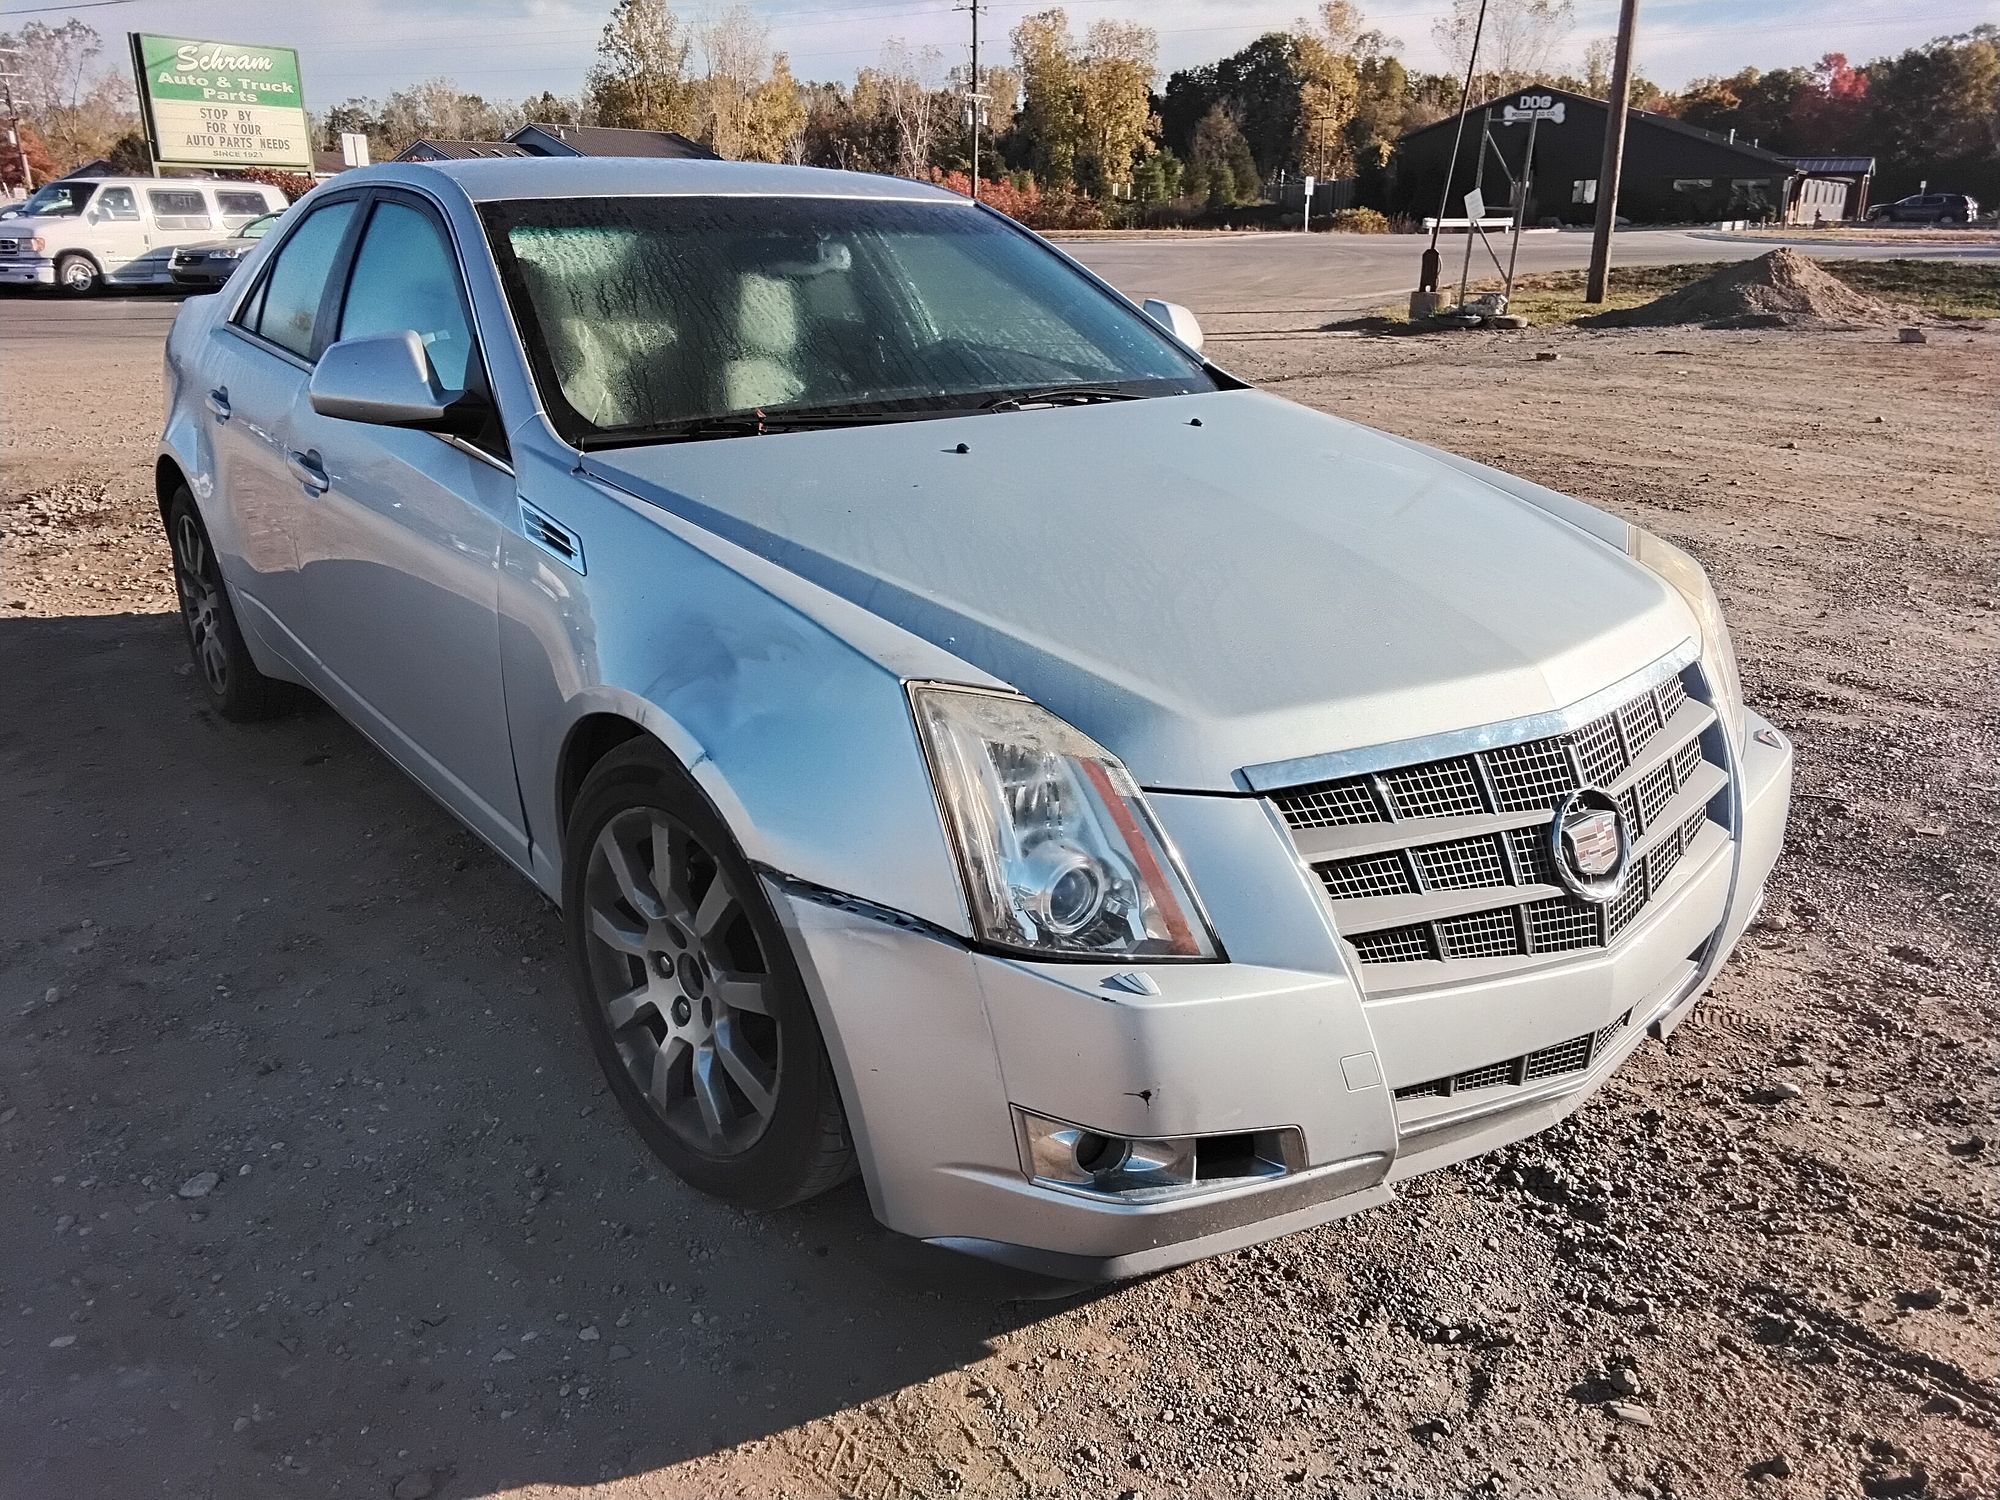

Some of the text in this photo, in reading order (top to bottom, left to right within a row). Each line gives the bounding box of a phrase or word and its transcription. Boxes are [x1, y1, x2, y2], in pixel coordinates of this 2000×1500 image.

[176, 45, 273, 72] Schram
[158, 72, 295, 94] Auto & Truck
[203, 87, 258, 102] Parts
[1519, 95, 1552, 109] DOG
[200, 107, 252, 121] STOP BY
[206, 121, 262, 136] FOR YOUR
[186, 134, 290, 151] AUTO PARTS NEEDS
[212, 150, 240, 158] SINCE
